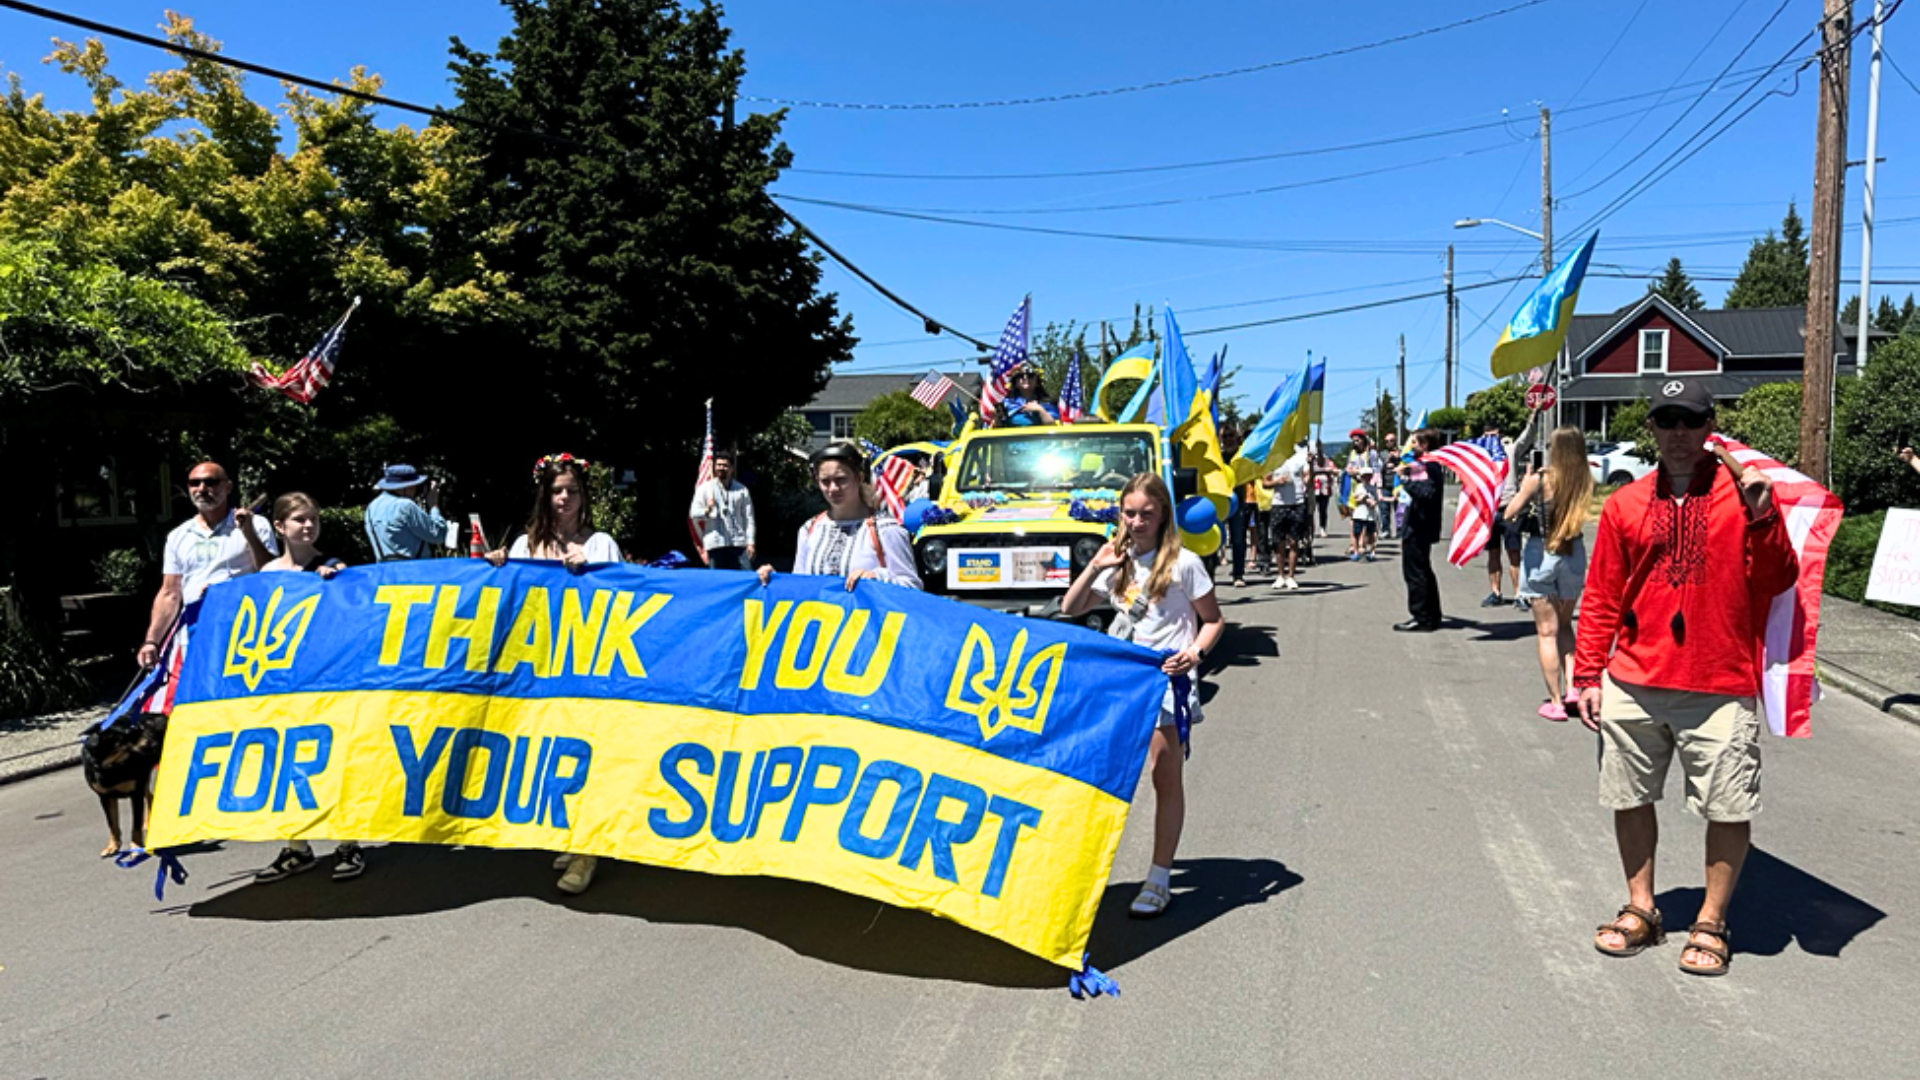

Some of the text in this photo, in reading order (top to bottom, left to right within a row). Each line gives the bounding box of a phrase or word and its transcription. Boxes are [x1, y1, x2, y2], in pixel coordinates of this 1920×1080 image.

[374, 585, 907, 697] THANK YOU
[178, 723, 1043, 899] FOR YOUR SUPPORT
